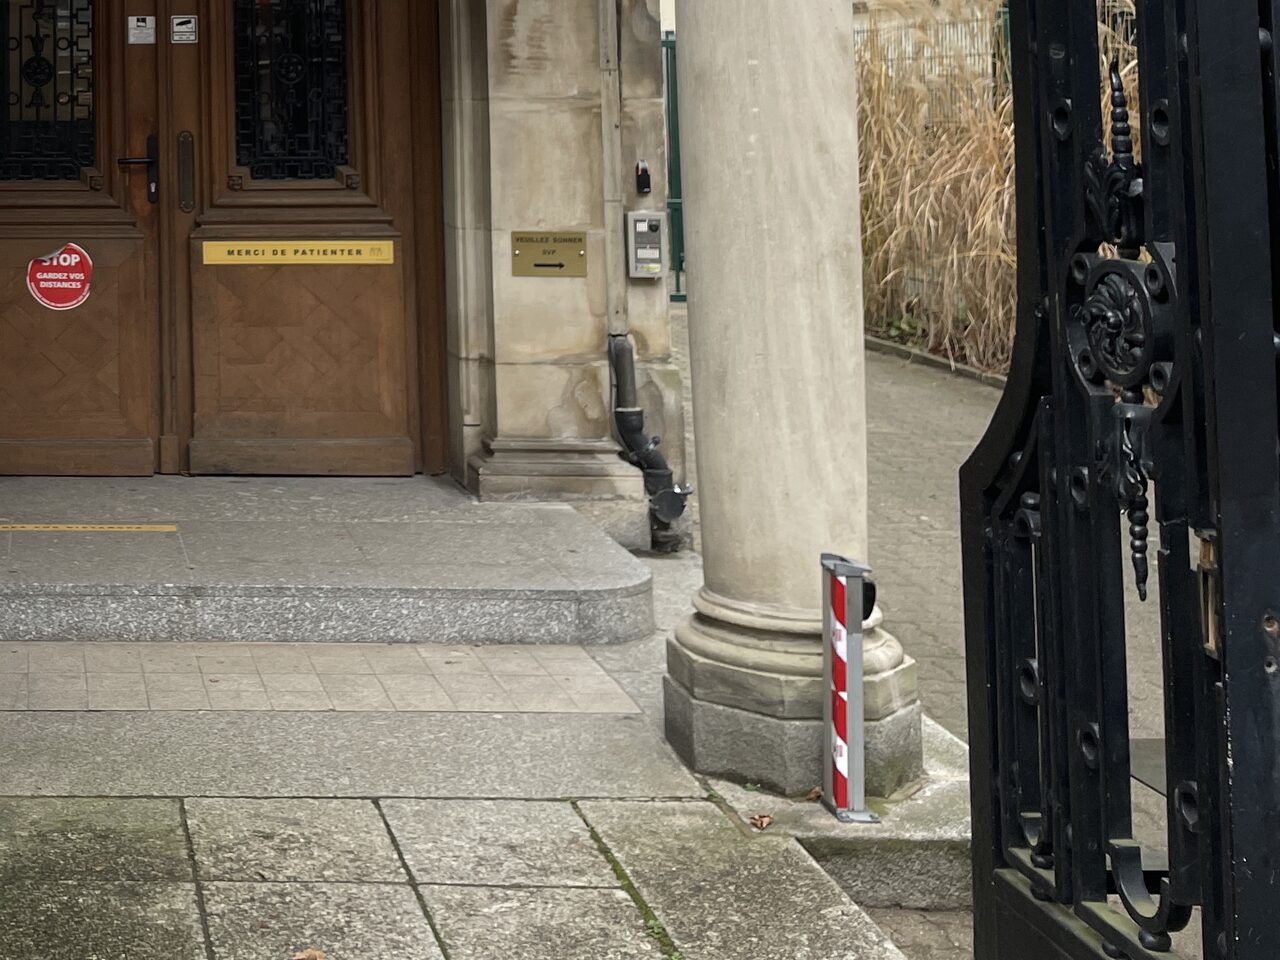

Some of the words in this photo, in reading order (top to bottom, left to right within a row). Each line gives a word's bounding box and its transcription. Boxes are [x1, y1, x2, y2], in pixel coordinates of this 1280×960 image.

[227, 249, 266, 257] MERCI
[271, 249, 287, 257] DE
[293, 249, 363, 257] PATIENTER
[36, 272, 68, 280] GARDEZ
[69, 272, 85, 280] VOS
[40, 281, 82, 289] DISTANCES
